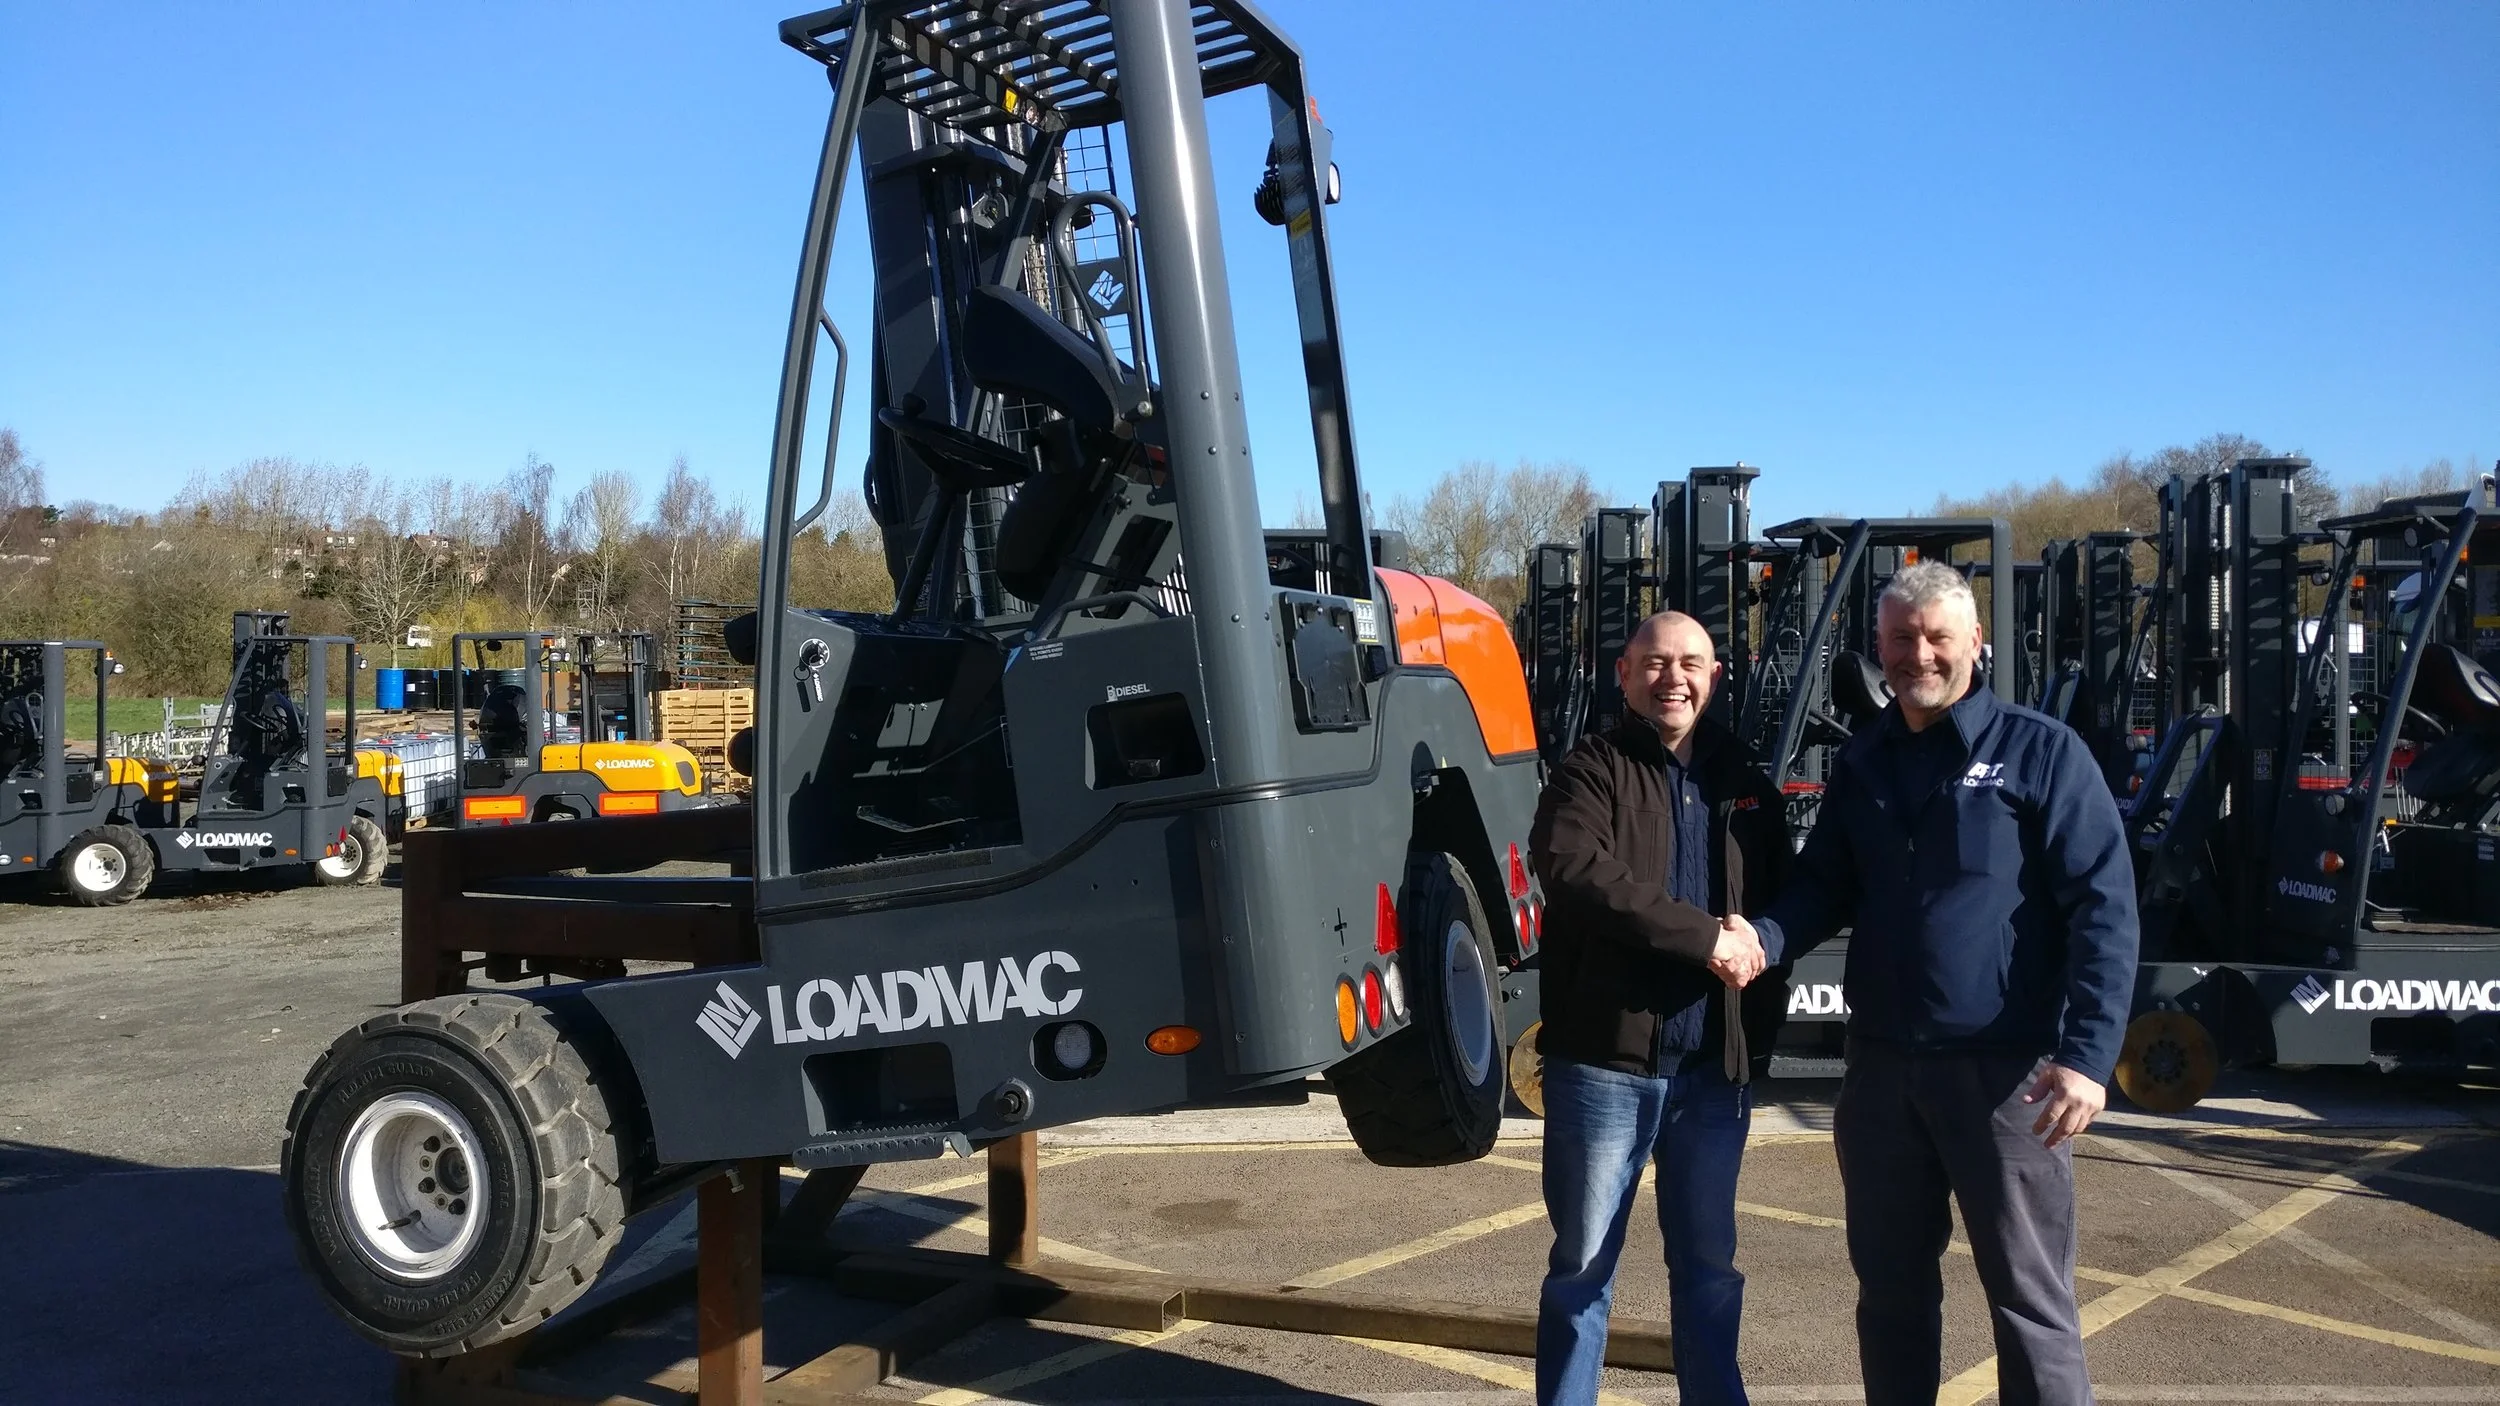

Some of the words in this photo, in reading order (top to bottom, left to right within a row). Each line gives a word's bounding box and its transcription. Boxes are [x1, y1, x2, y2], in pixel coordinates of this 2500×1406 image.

[1116, 683, 1150, 697] DIESEL
[606, 758, 655, 769] LOADMAC
[195, 832, 273, 847] LOADMAC
[2288, 880, 2337, 904] LOADMAC
[766, 950, 1083, 1045] LOADMAC
